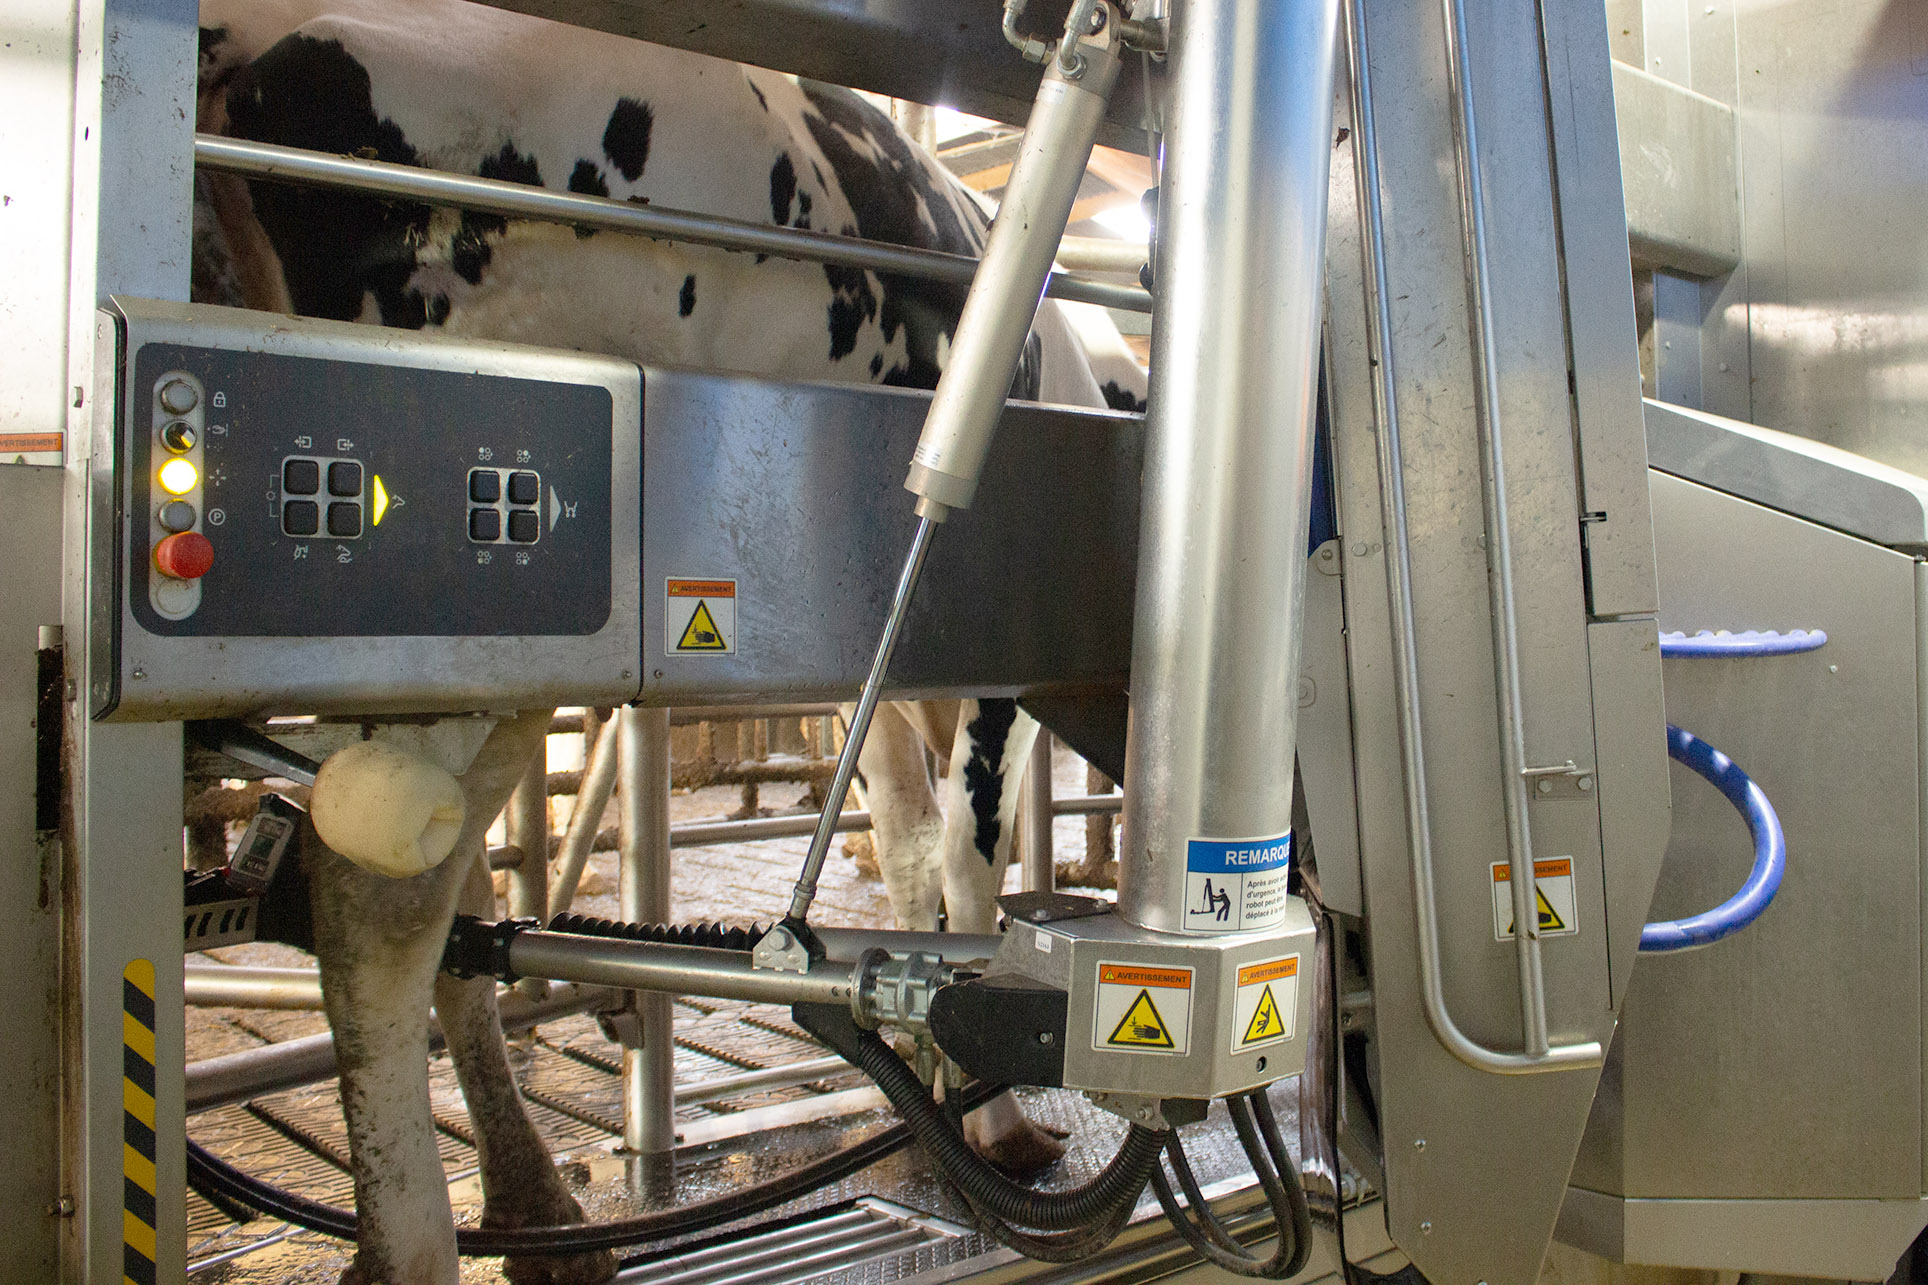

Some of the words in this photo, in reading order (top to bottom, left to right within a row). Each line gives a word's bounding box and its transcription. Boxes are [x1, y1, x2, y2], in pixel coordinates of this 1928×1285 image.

[1247, 879, 1266, 890] Après
[1246, 900, 1264, 909] robot
[1250, 963, 1295, 979] AVERTISSEMENT
[1117, 972, 1187, 983] AVERTISSEMENT
